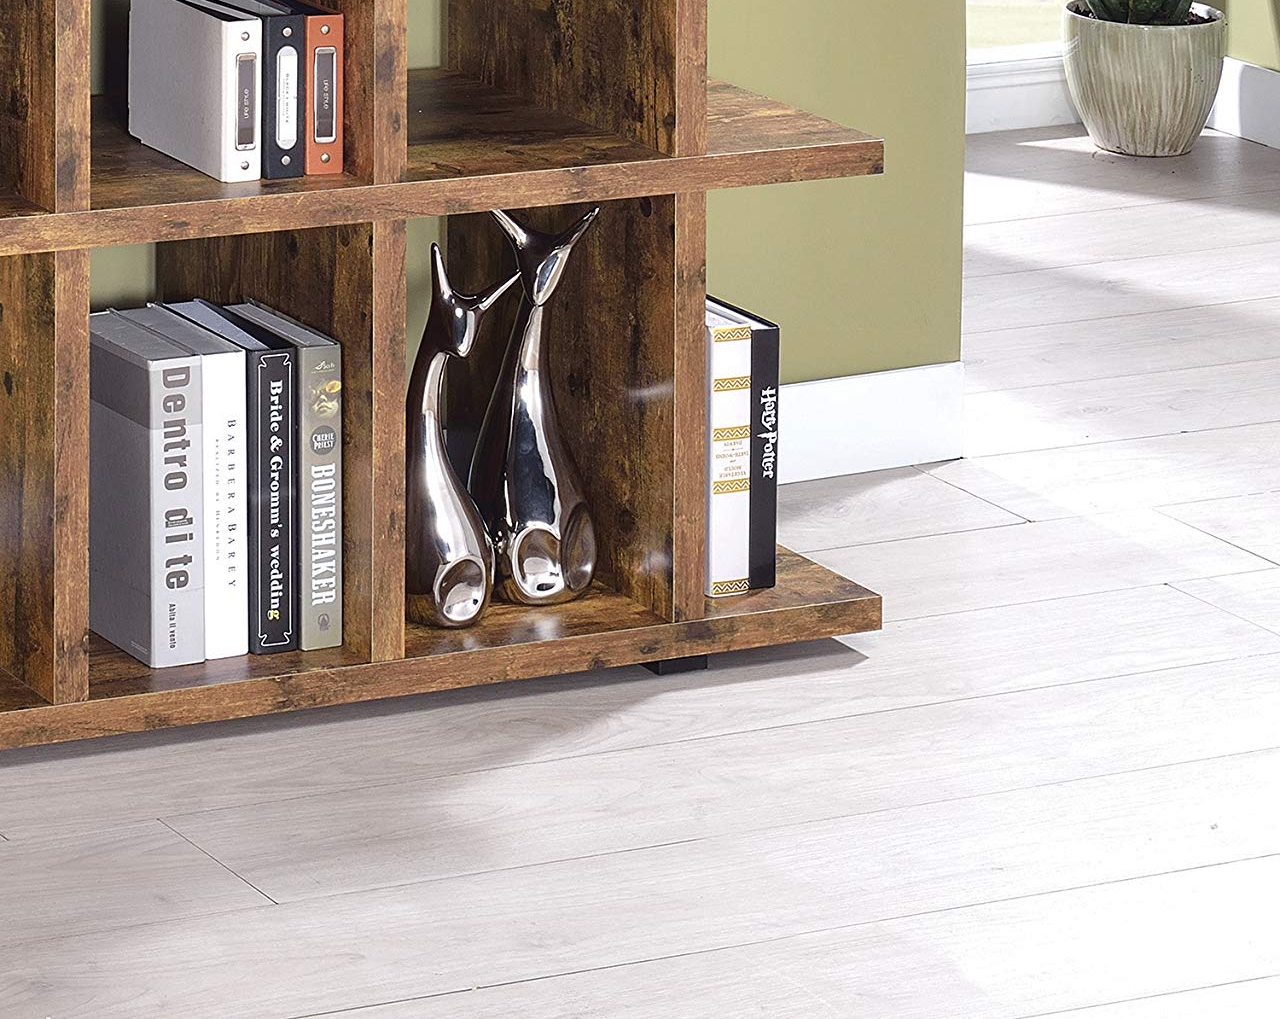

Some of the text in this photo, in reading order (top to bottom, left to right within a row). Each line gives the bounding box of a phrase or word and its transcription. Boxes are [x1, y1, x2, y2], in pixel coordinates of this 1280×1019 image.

[162, 366, 191, 491] Dentro
[270, 380, 283, 432] Bride
[270, 434, 283, 453] &
[757, 386, 777, 479] Harry Potter
[314, 441, 334, 450] PRIEST
[311, 463, 336, 605] BONESHAKER
[267, 544, 283, 621] wedding
